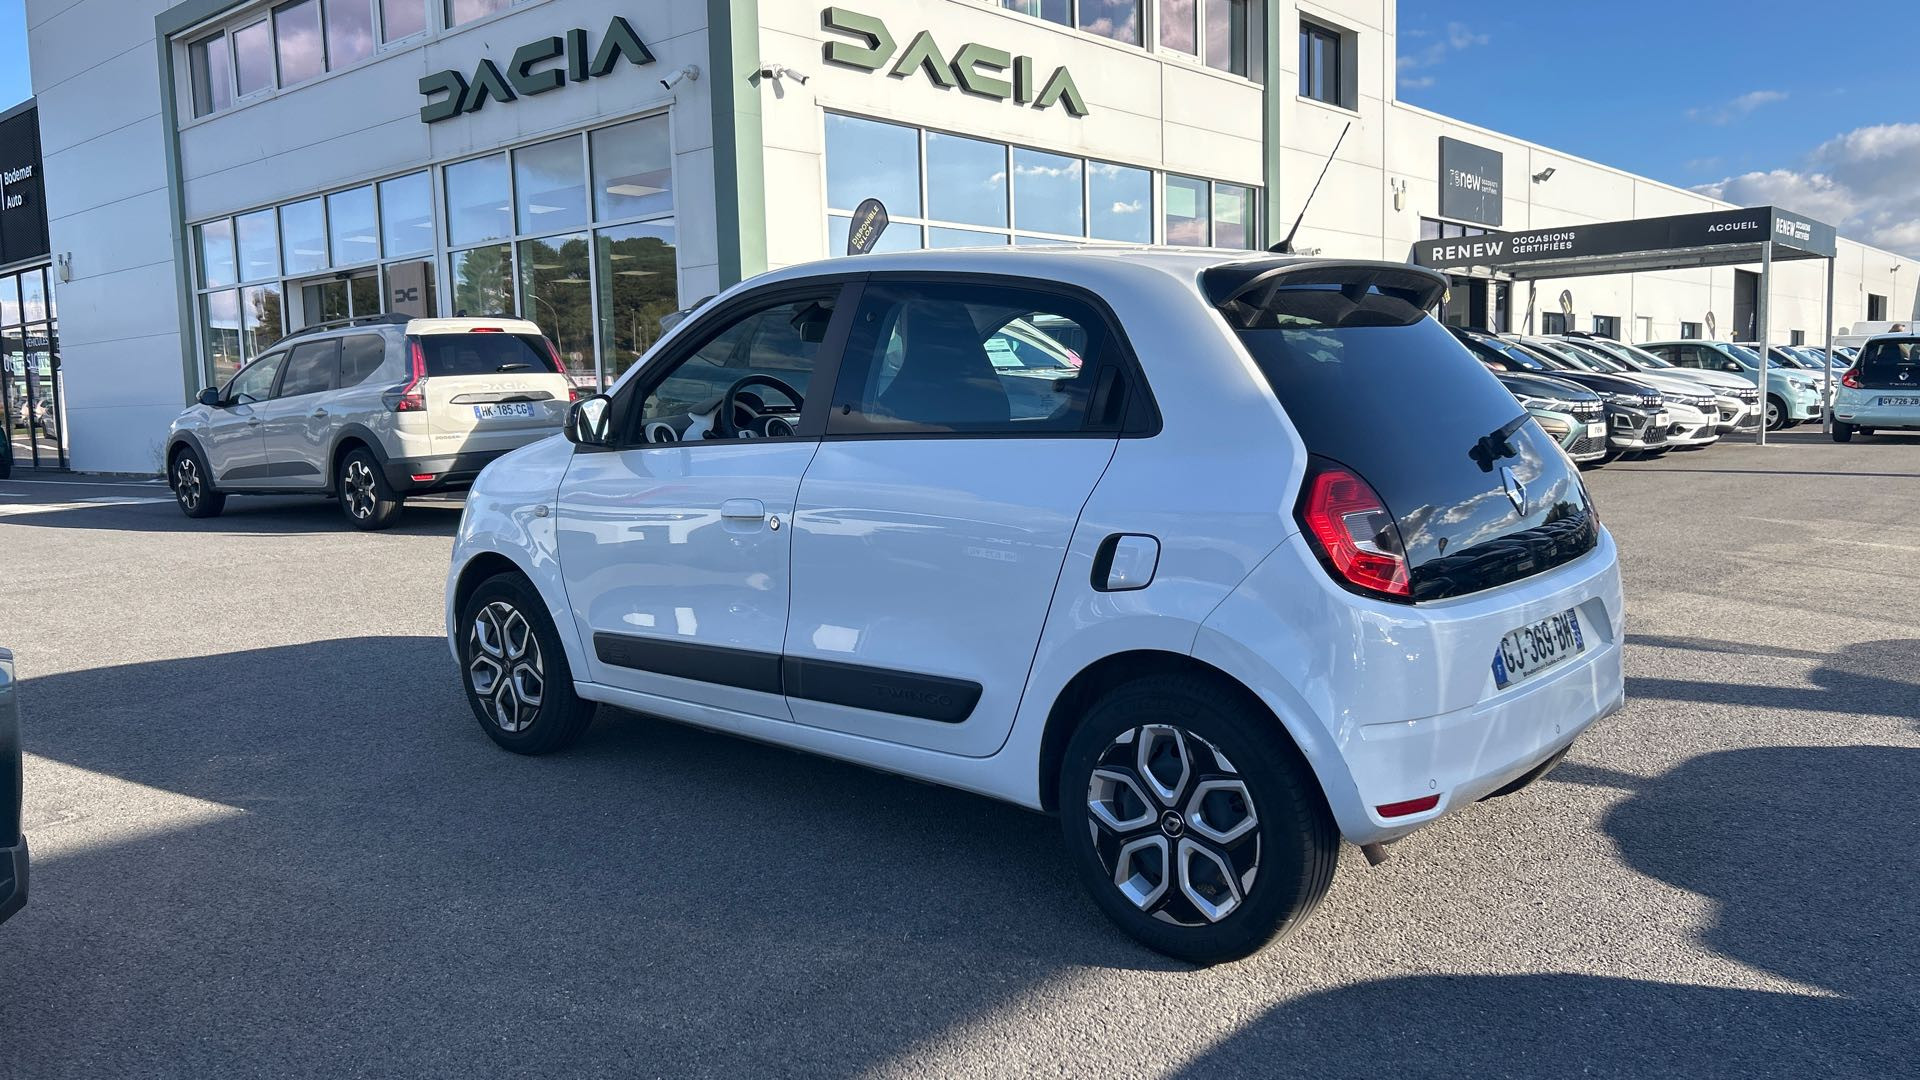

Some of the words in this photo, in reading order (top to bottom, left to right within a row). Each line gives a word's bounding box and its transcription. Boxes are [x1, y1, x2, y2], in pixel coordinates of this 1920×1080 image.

[419, 15, 656, 123] DACIA
[820, 6, 1089, 119] DACIA
[4, 165, 32, 185] Bodemer
[7, 194, 22, 209] Auto
[852, 205, 880, 246] DISPONIBLE
[1708, 221, 1758, 232] ACCUEIL
[1775, 217, 1796, 237] RENEW
[856, 239, 865, 250] EN
[862, 225, 874, 241] LOA
[1512, 232, 1575, 245] OCCASIONS
[1512, 240, 1573, 254] CERTIFIÉES
[1432, 241, 1504, 261] RENEW
[481, 404, 528, 416] HK-185-CG
